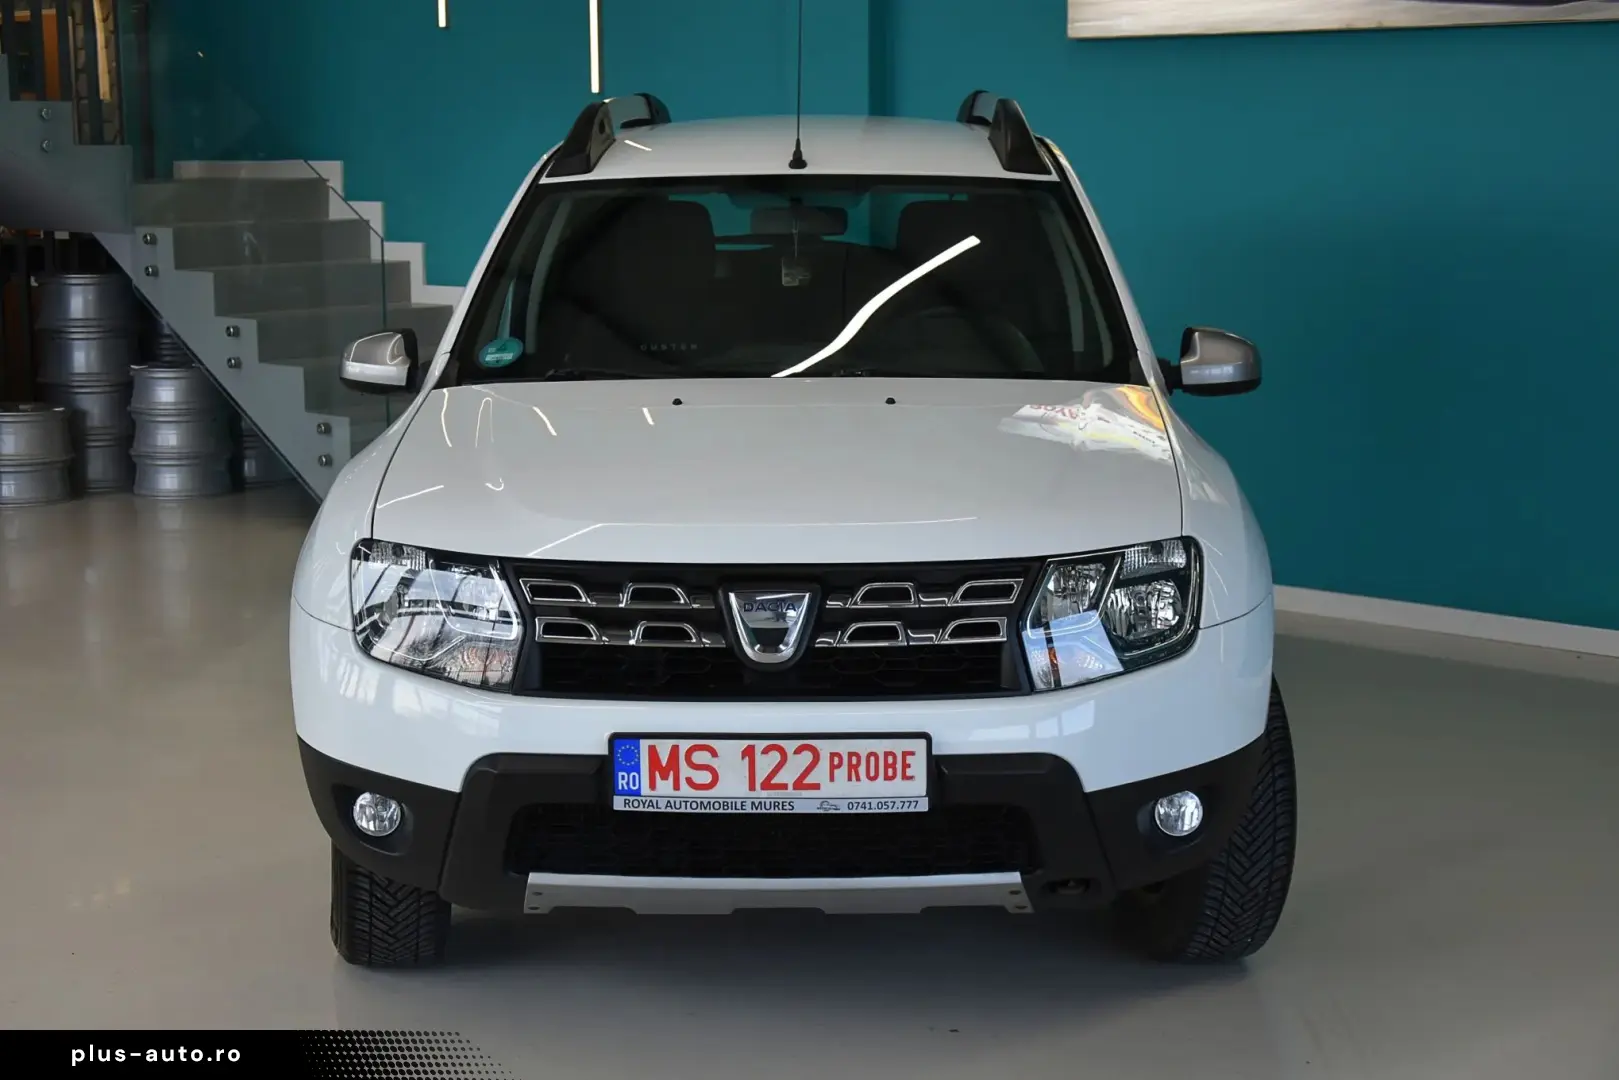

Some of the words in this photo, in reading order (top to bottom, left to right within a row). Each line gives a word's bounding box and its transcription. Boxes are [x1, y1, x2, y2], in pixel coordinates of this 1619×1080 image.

[743, 602, 797, 612] DACIA
[647, 743, 720, 791] MS
[741, 743, 821, 792] 122
[829, 751, 915, 782] PROBE
[618, 771, 639, 790] RO
[623, 798, 662, 810] ROYAL
[665, 799, 747, 811] AUTOMOBILE
[750, 800, 795, 811] MURES
[847, 800, 919, 811] 0741.057.777
